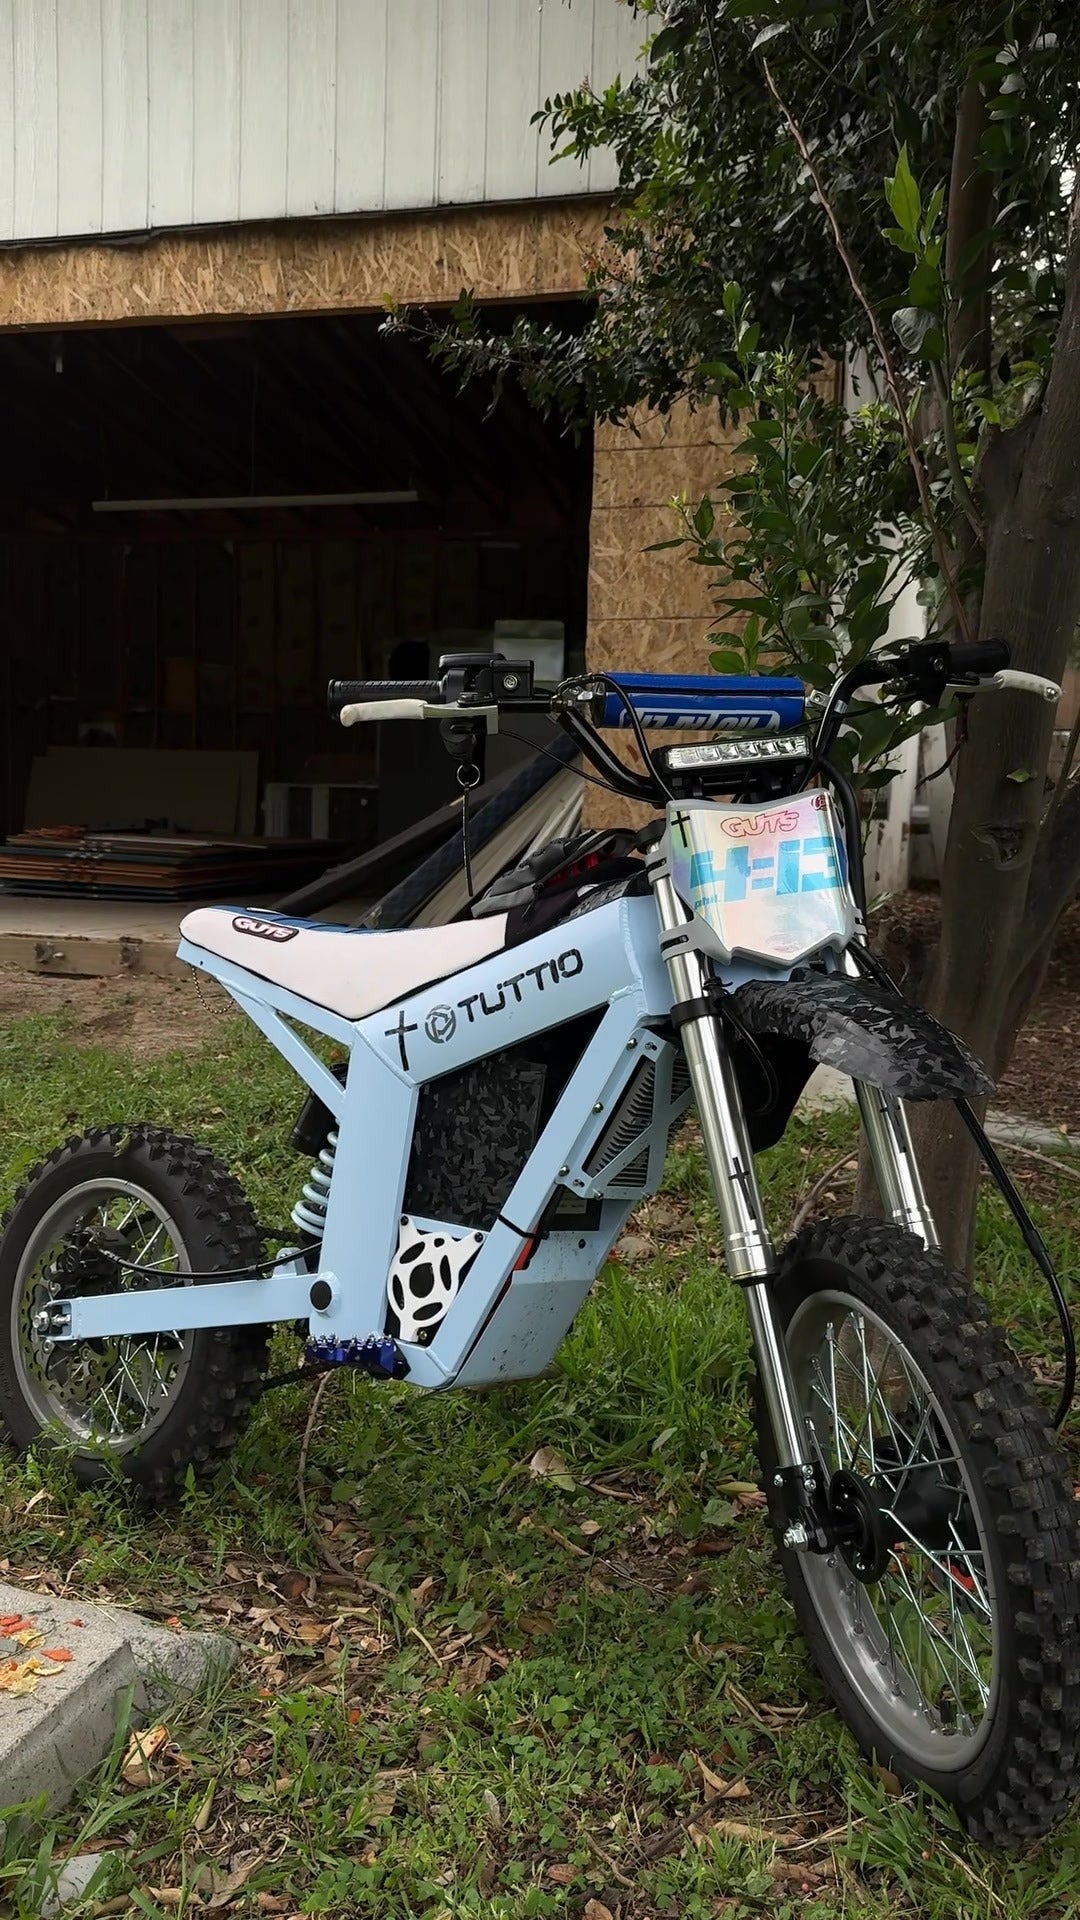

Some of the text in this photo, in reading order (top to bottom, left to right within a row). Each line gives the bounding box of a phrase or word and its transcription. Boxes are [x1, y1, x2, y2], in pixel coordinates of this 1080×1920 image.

[720, 810, 800, 838] GUTS
[234, 916, 295, 939] GUTS
[457, 948, 584, 1022] TUTTIO
